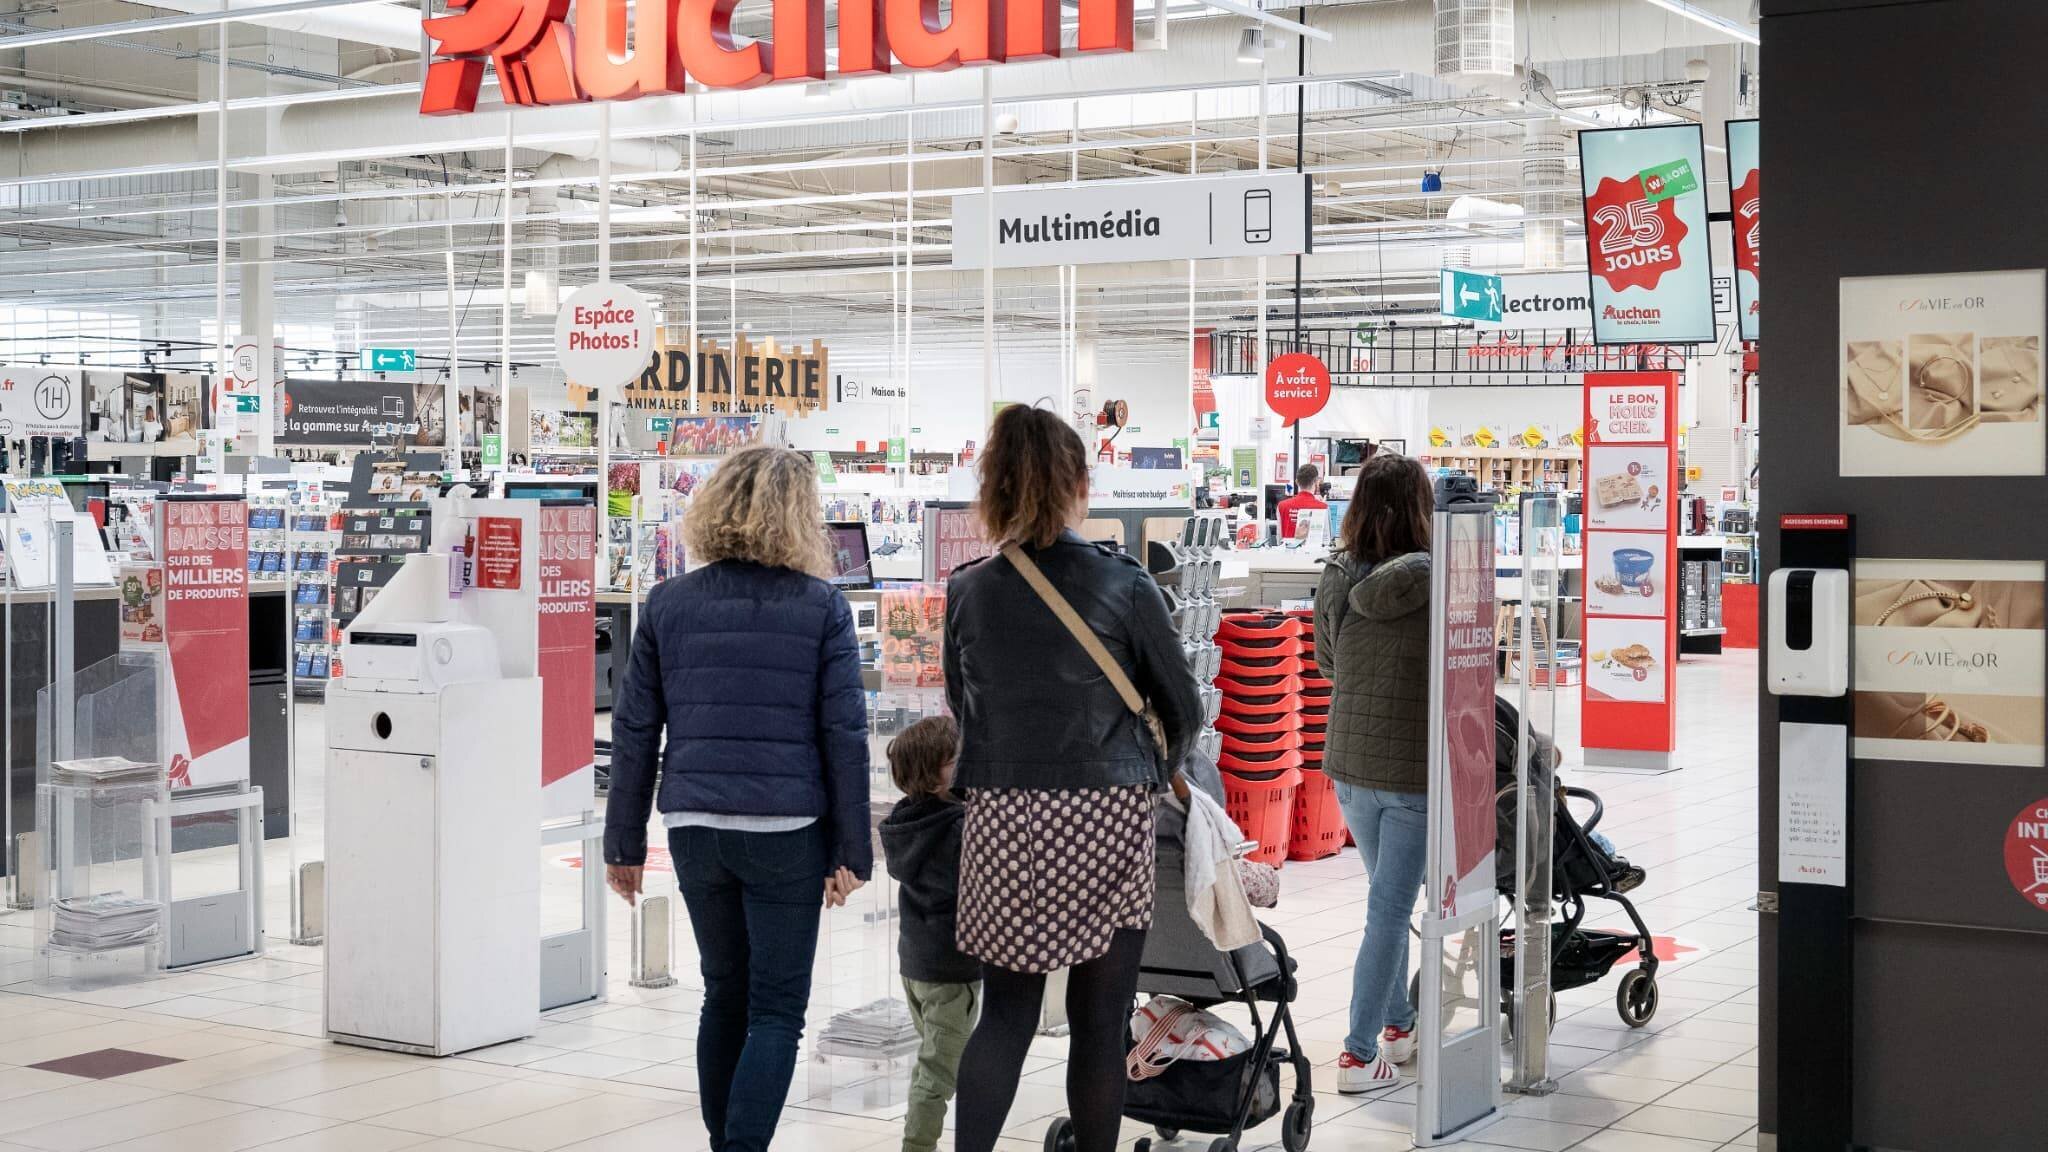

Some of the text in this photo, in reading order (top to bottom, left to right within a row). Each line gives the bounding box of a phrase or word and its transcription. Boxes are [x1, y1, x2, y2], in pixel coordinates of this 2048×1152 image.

[1000, 208, 1160, 244] Multimédia
[1593, 199, 1664, 254] 25
[1605, 245, 1673, 272] JOURS
[1501, 293, 1592, 314] lectrom
[1964, 296, 1984, 309] OR
[575, 305, 634, 329] Espace
[1602, 304, 1661, 319] Auchan
[570, 331, 629, 350] Photos
[1276, 371, 1316, 385] À votre
[41, 386, 63, 408] 1H
[871, 386, 895, 397] Maison
[1274, 387, 1312, 398] service
[1610, 394, 1658, 405] LE BON,
[298, 404, 378, 416] Retrouvez l'intégralité
[1609, 405, 1657, 419] MOINS
[290, 418, 300, 431] la
[302, 421, 342, 435] gamme
[343, 423, 359, 432] sur
[1608, 419, 1651, 434] CHER.
[168, 503, 244, 525] PRIX EN
[168, 526, 244, 551] BAISSE
[168, 555, 213, 566] SUR DES
[168, 568, 244, 585] MILLIERS
[541, 566, 561, 576] DES
[168, 590, 183, 600] DE
[1449, 610, 1477, 624] SUR DES
[1449, 627, 1493, 648] MILLIERS
[1448, 656, 1458, 669] DE
[1925, 651, 1954, 667] VIE
[1972, 652, 1998, 668] OR
